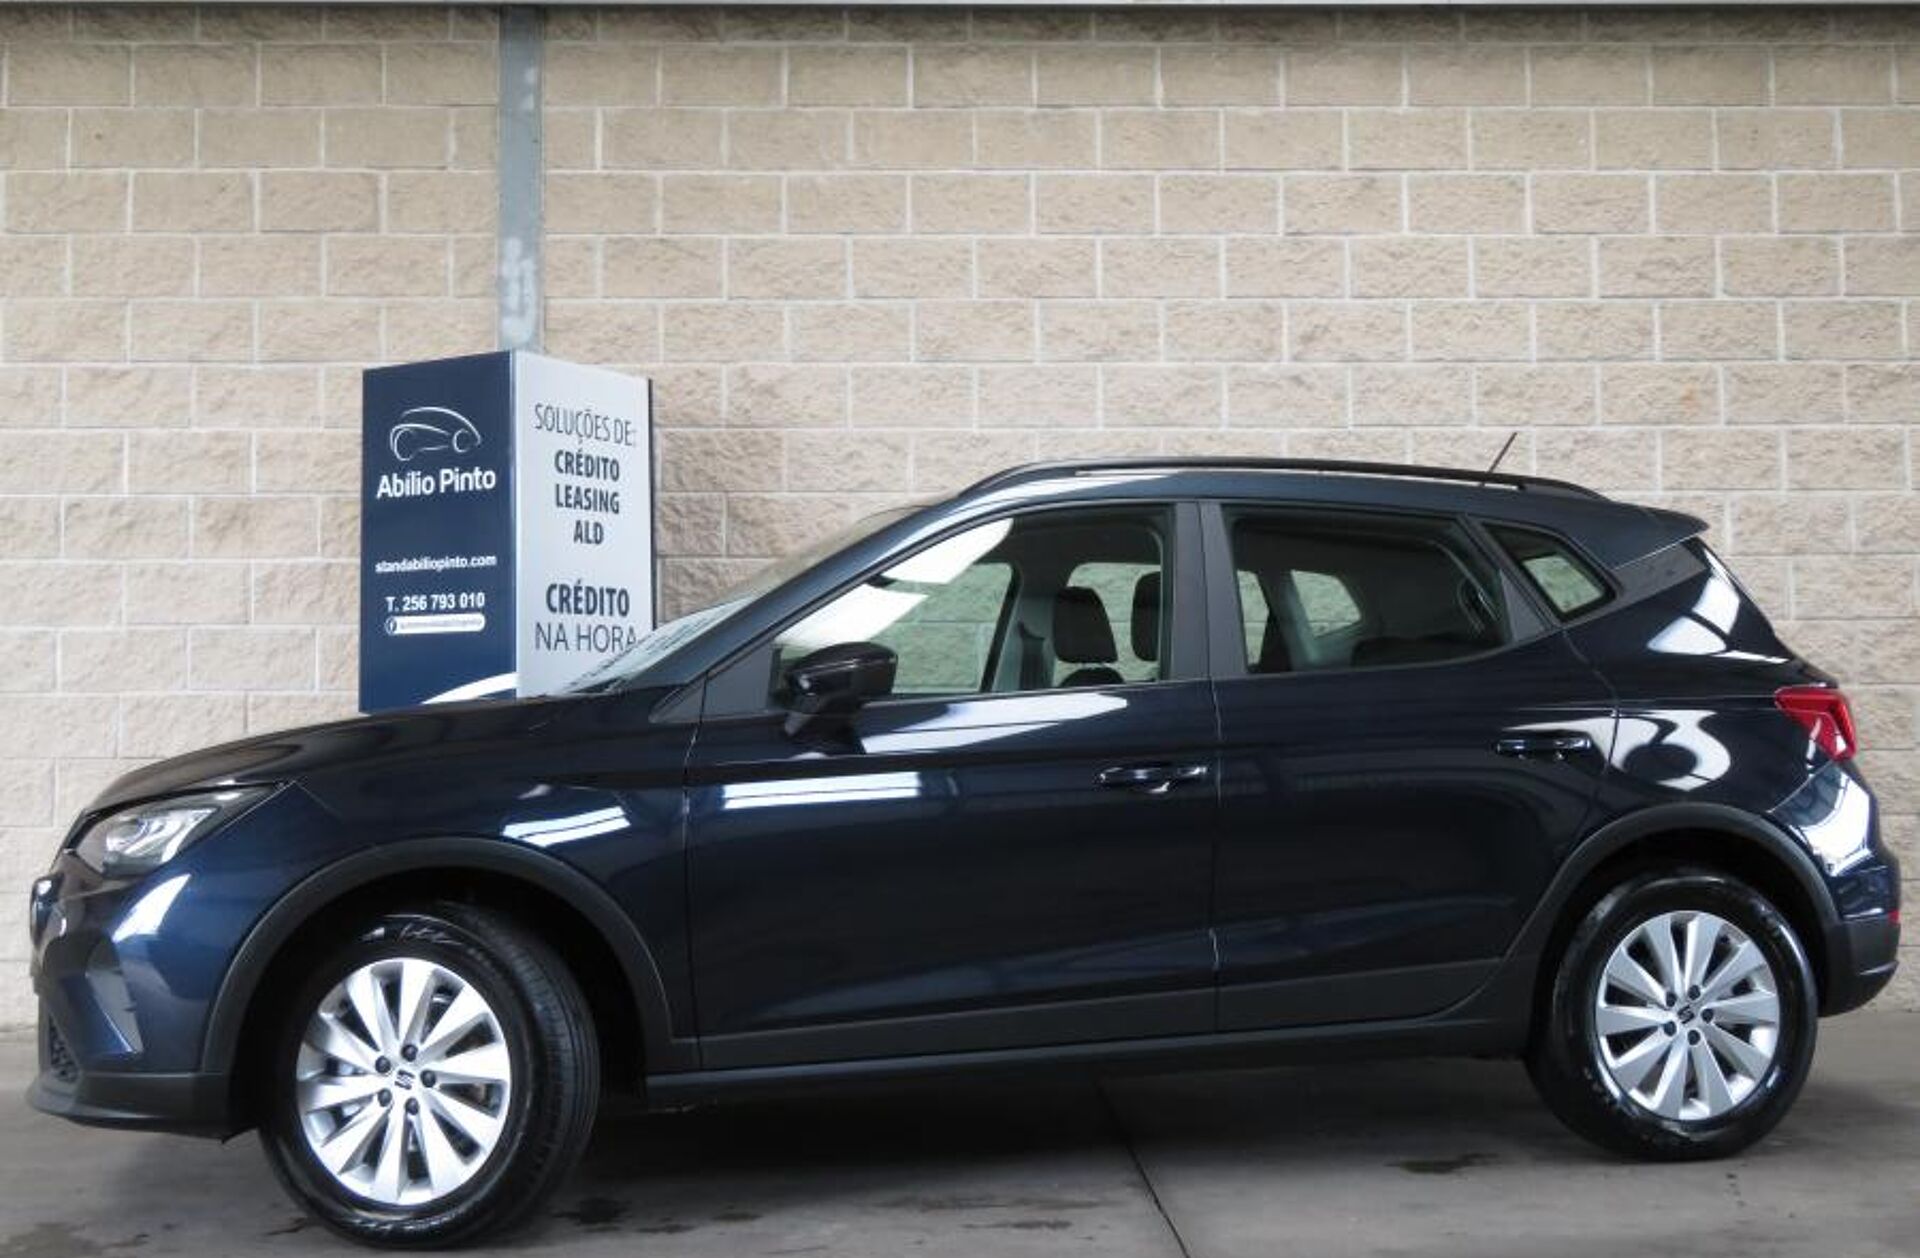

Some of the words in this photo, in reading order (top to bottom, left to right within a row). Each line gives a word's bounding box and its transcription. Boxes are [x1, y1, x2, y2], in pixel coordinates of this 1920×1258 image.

[534, 402, 610, 445] SOLUÇÕES
[440, 466, 496, 494] Pinto
[554, 448, 620, 482] CRÉDITO
[556, 483, 620, 515] LEASING
[573, 519, 605, 545] ALD
[375, 555, 497, 573] standabiliopinto.com
[385, 596, 400, 612] T.
[402, 594, 427, 612] 256
[431, 593, 455, 610] 793
[459, 592, 485, 609] 010
[546, 579, 630, 617] CRÉDITO
[535, 621, 570, 652] NA
[576, 623, 637, 653] HORA
